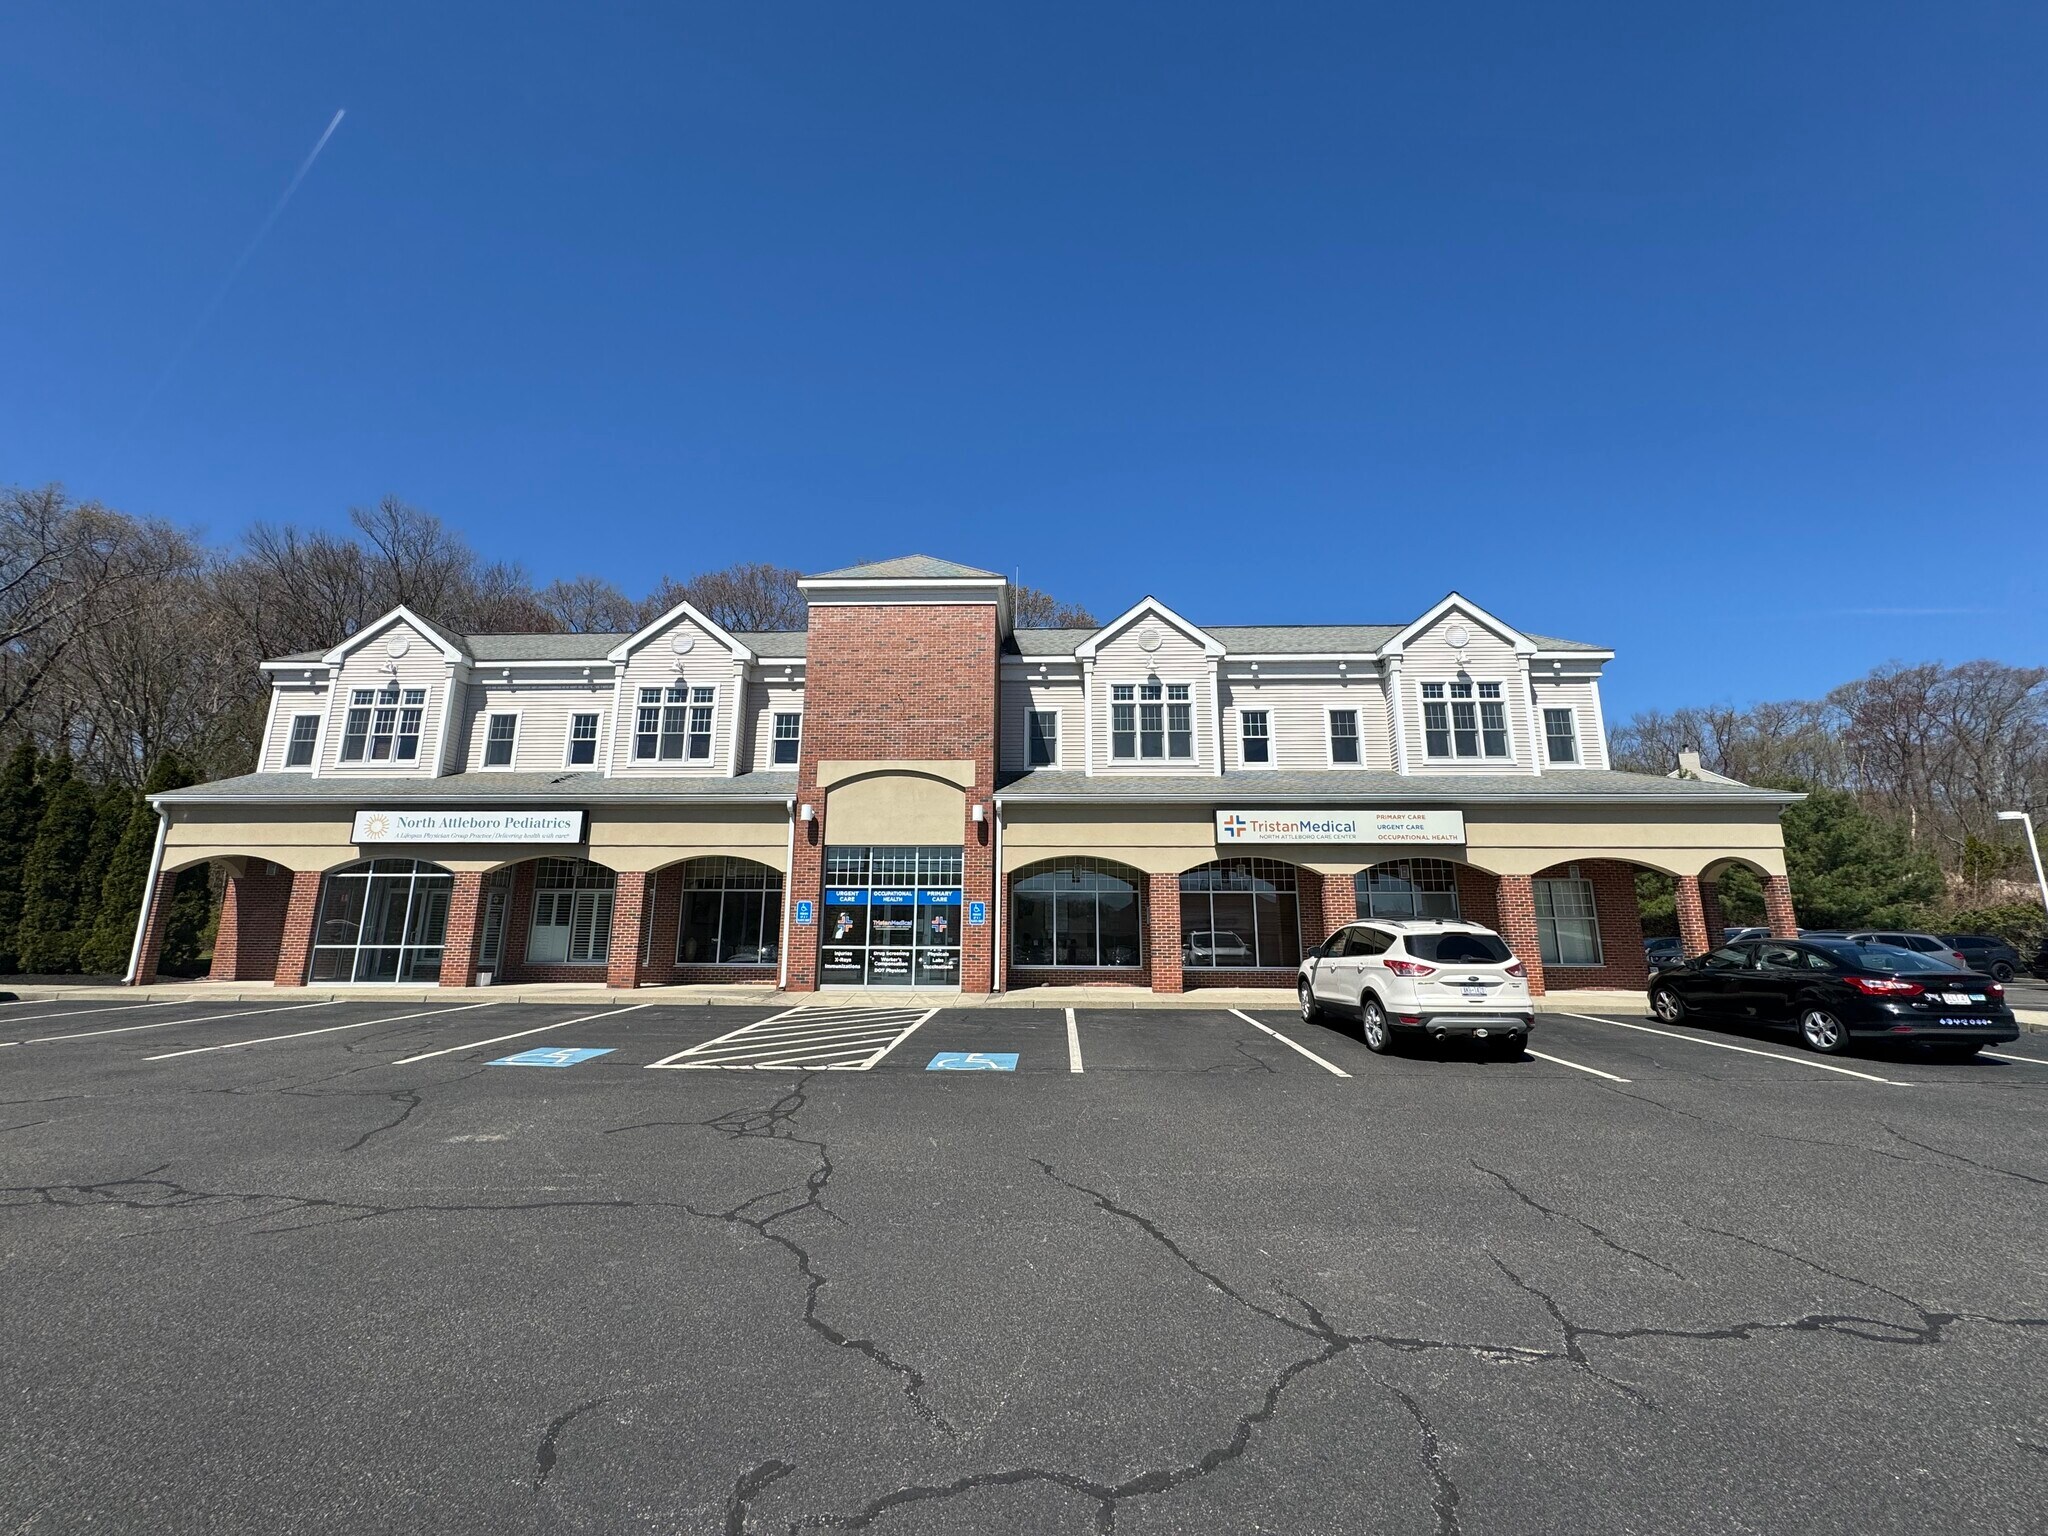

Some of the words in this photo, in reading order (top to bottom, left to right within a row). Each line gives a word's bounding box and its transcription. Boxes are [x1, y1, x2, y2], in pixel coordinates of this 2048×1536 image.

[396, 816, 436, 829] North
[438, 816, 501, 829] Attleboro
[504, 817, 571, 829] Pediatrics
[1249, 820, 1356, 832] TristanMedical
[423, 832, 450, 840] Physician
[450, 832, 469, 840] Group
